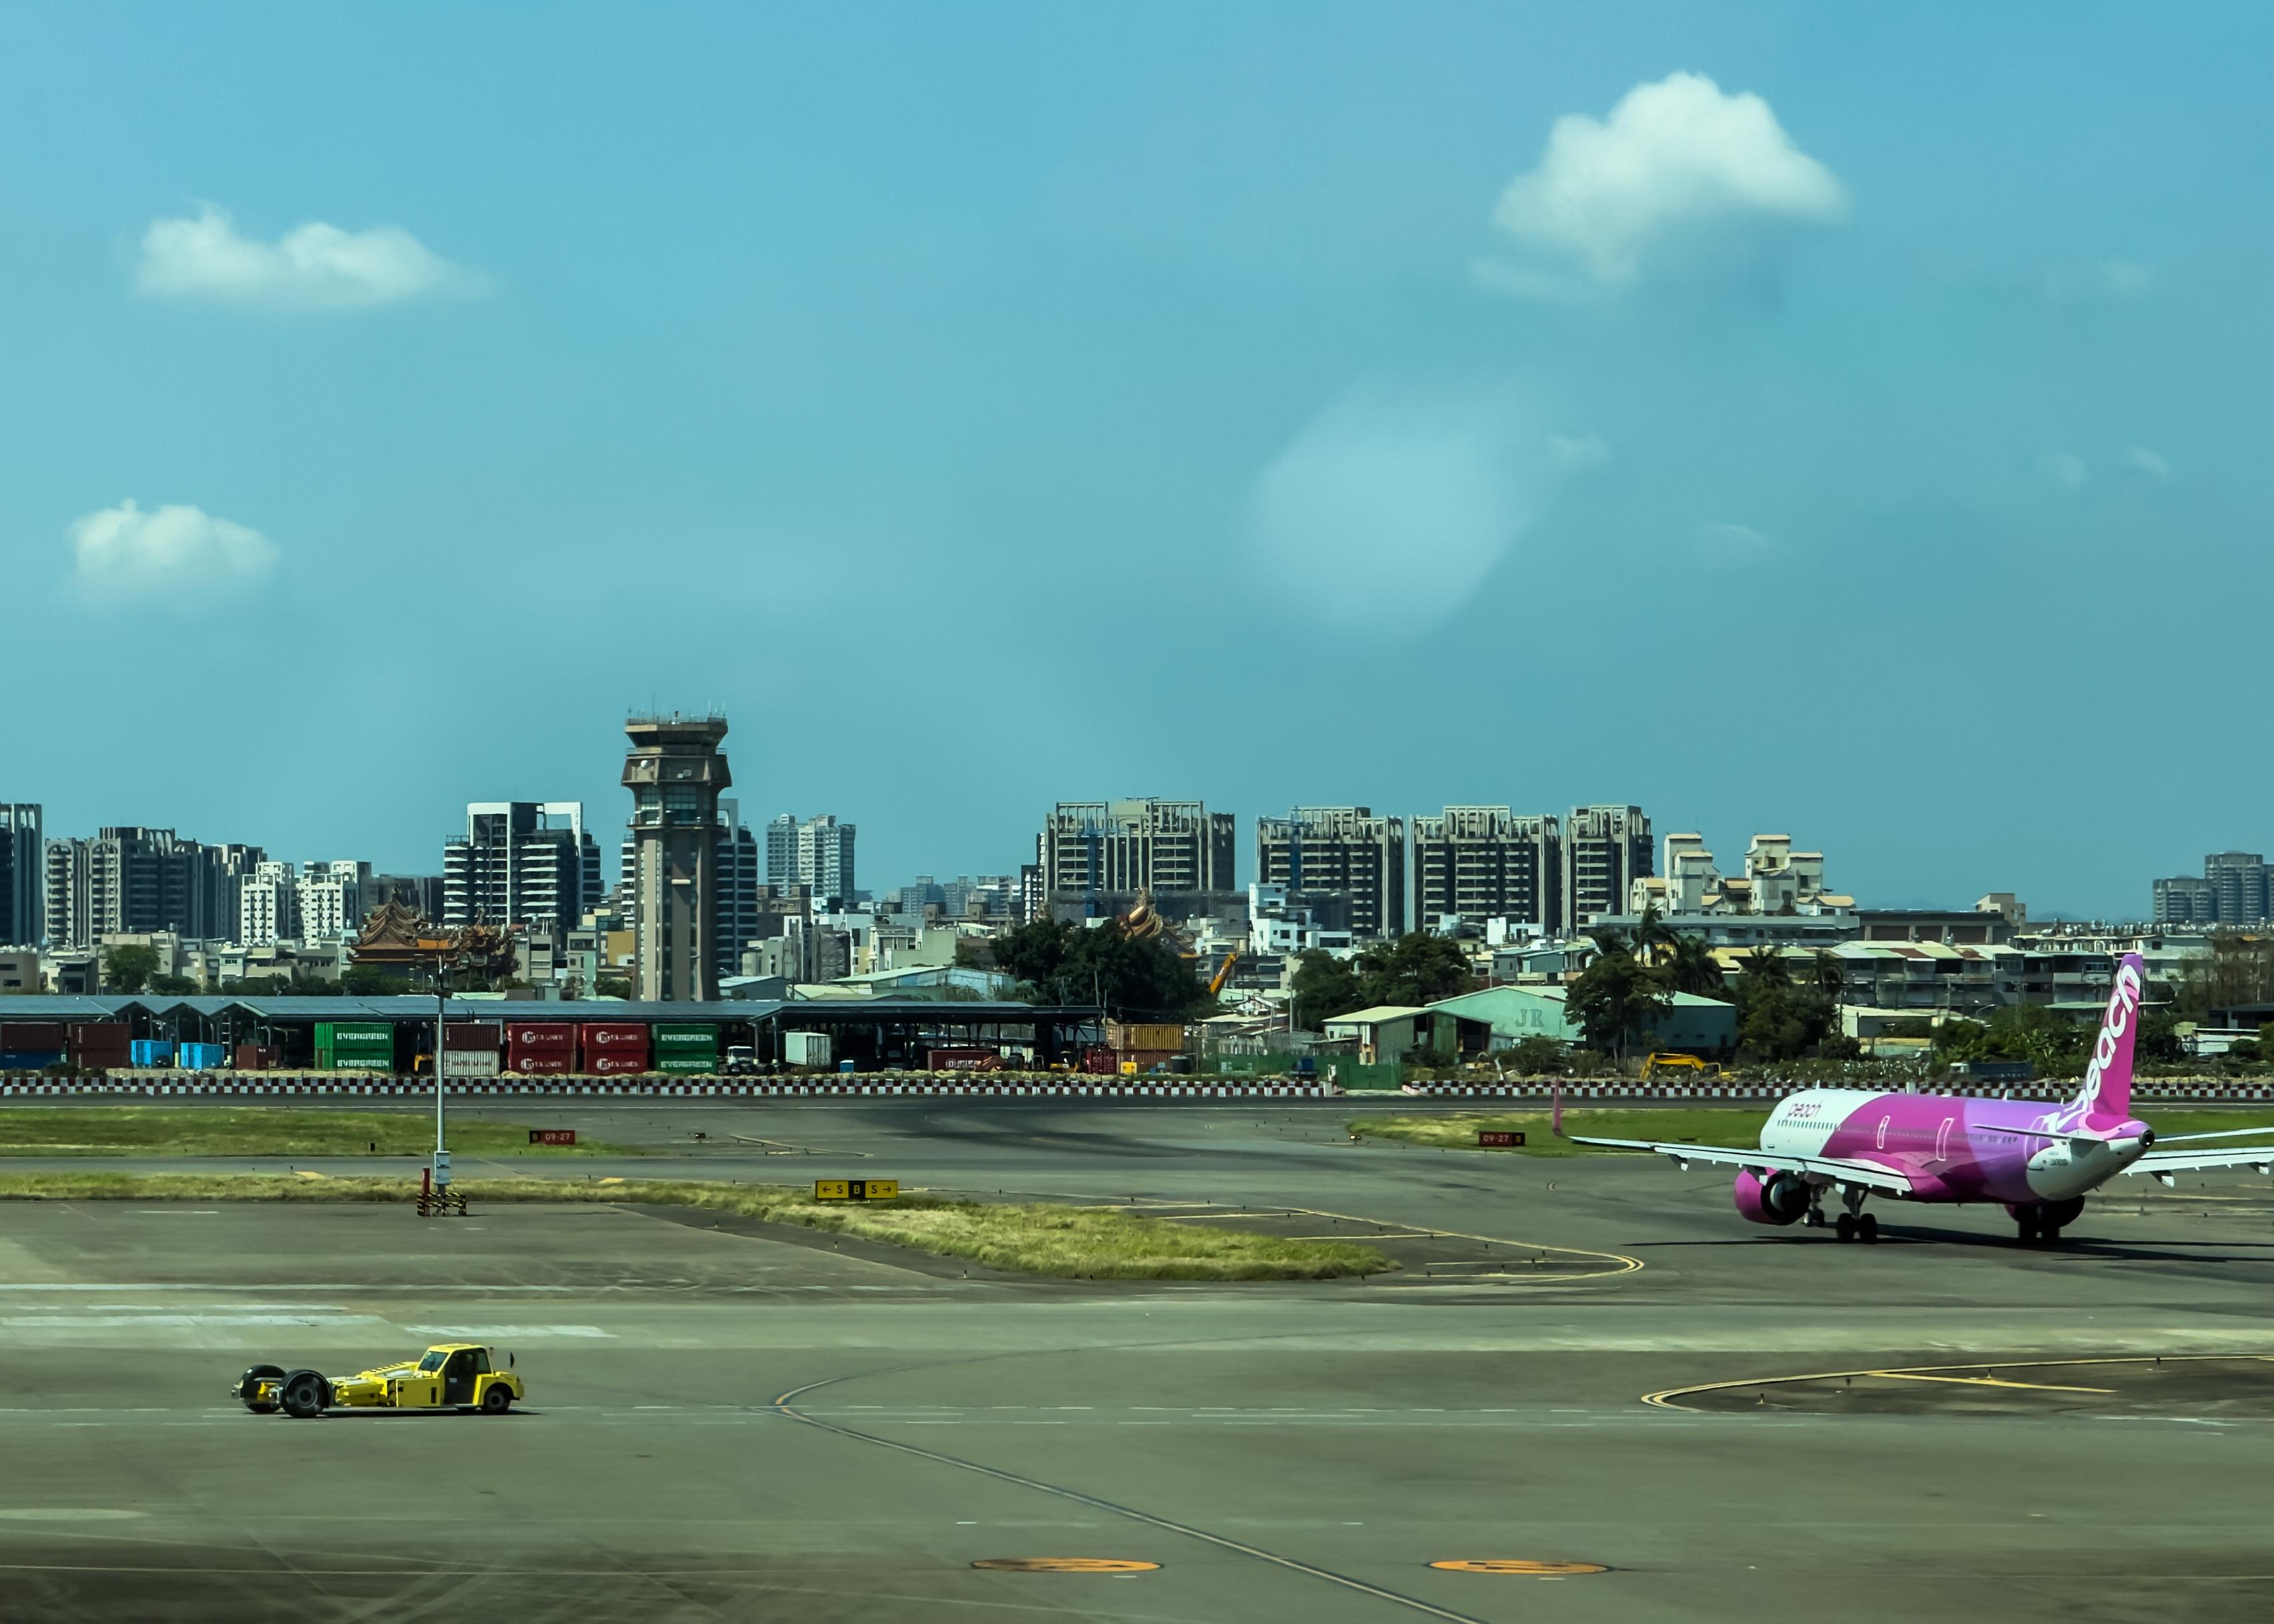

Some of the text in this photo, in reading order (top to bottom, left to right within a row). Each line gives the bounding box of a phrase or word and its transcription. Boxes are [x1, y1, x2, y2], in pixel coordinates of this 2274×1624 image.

[1515, 1009, 1545, 1028] JR
[336, 1032, 388, 1040] EVERGREEN
[2047, 965, 2141, 1146] peach
[544, 1133, 571, 1141] 09-27
[1483, 1134, 1509, 1142] 09-27
[837, 1185, 843, 1194] S
[871, 1185, 877, 1194] S
